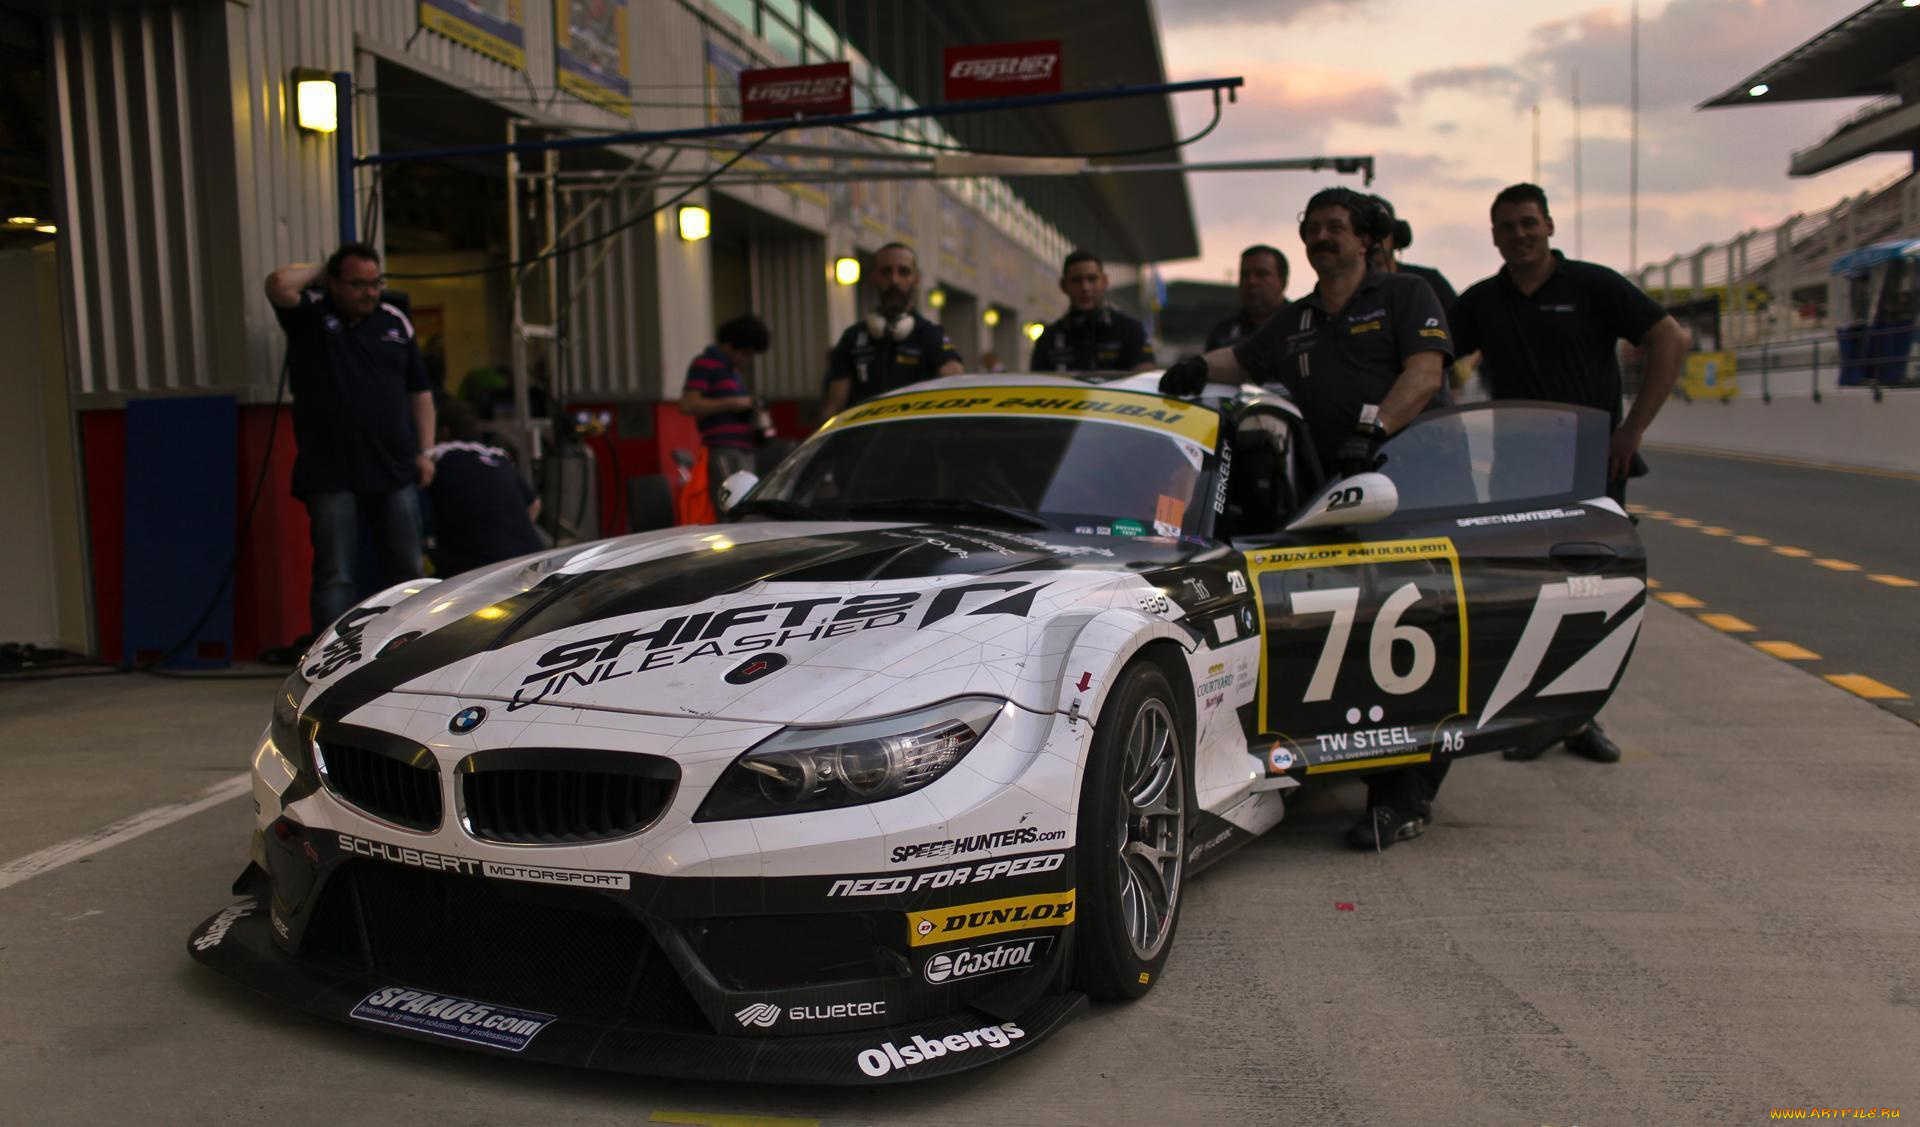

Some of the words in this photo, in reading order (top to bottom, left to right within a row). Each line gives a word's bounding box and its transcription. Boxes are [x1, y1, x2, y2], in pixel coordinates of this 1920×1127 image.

[1069, 400, 1184, 425] DUBAI
[1213, 439, 1232, 515] BERKELEY
[1326, 486, 1364, 511] 2D
[1269, 550, 1342, 564] DUNLOP
[1377, 545, 1417, 555] DUBAI
[1419, 543, 1447, 553] 2011
[1138, 594, 1169, 614] BBS
[1290, 581, 1436, 703] 76
[506, 612, 907, 712] UNLEASHED
[1197, 674, 1233, 698] COURTYARD
[1316, 733, 1347, 753] TW
[1353, 726, 1417, 749] STEEL
[339, 834, 479, 874] SCHUBERT
[489, 865, 623, 886] MOTORSPORT
[890, 827, 1065, 863] SPEEDHUNTERS.com
[827, 876, 913, 897] NEED
[912, 867, 973, 892] FOR
[970, 853, 1066, 883] SPEED
[942, 900, 1075, 933] DUNLOP
[953, 941, 1035, 976] Castrol
[857, 1021, 1025, 1077] Olsbergs
